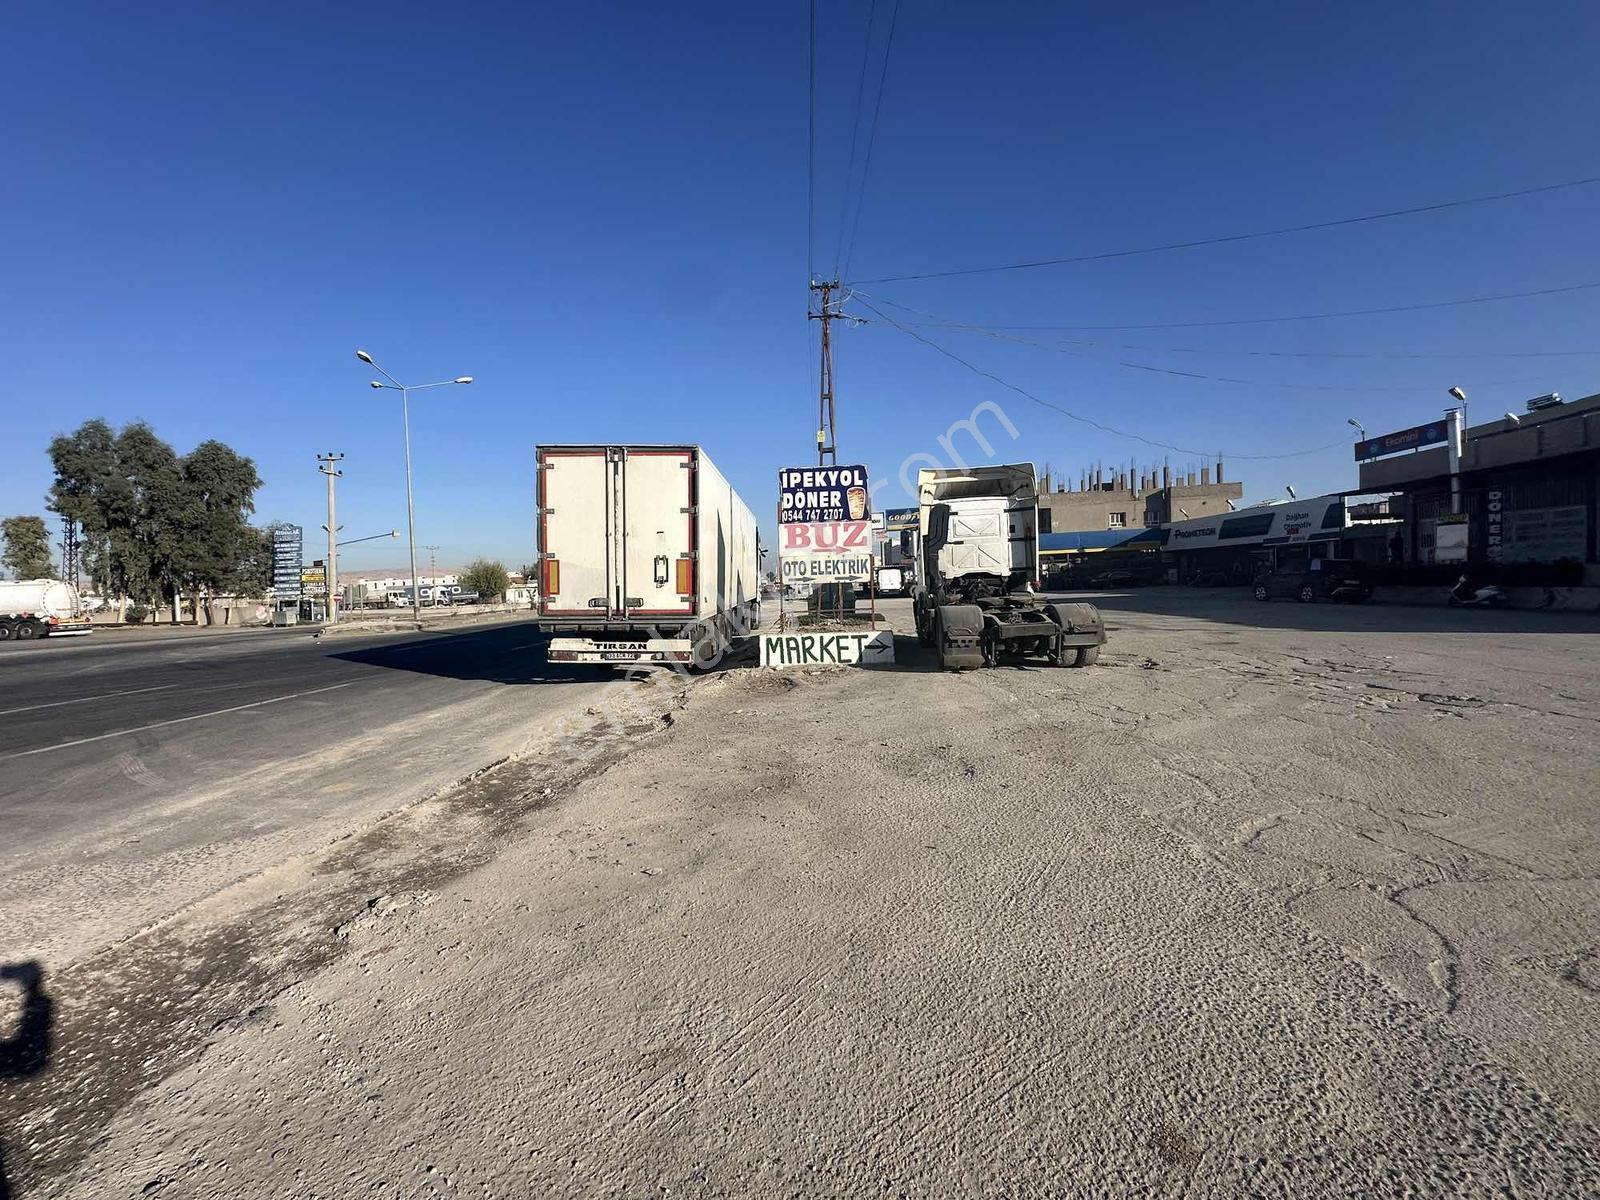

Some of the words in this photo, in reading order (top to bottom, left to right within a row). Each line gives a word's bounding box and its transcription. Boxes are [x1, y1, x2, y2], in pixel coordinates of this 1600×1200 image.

[782, 489, 842, 509] DÖNER
[783, 510, 803, 521] 0544
[806, 509, 821, 520] 747
[824, 508, 844, 519] 2707
[784, 523, 867, 549] BUZ
[783, 560, 807, 576] OTO
[765, 634, 869, 666] MARKET
